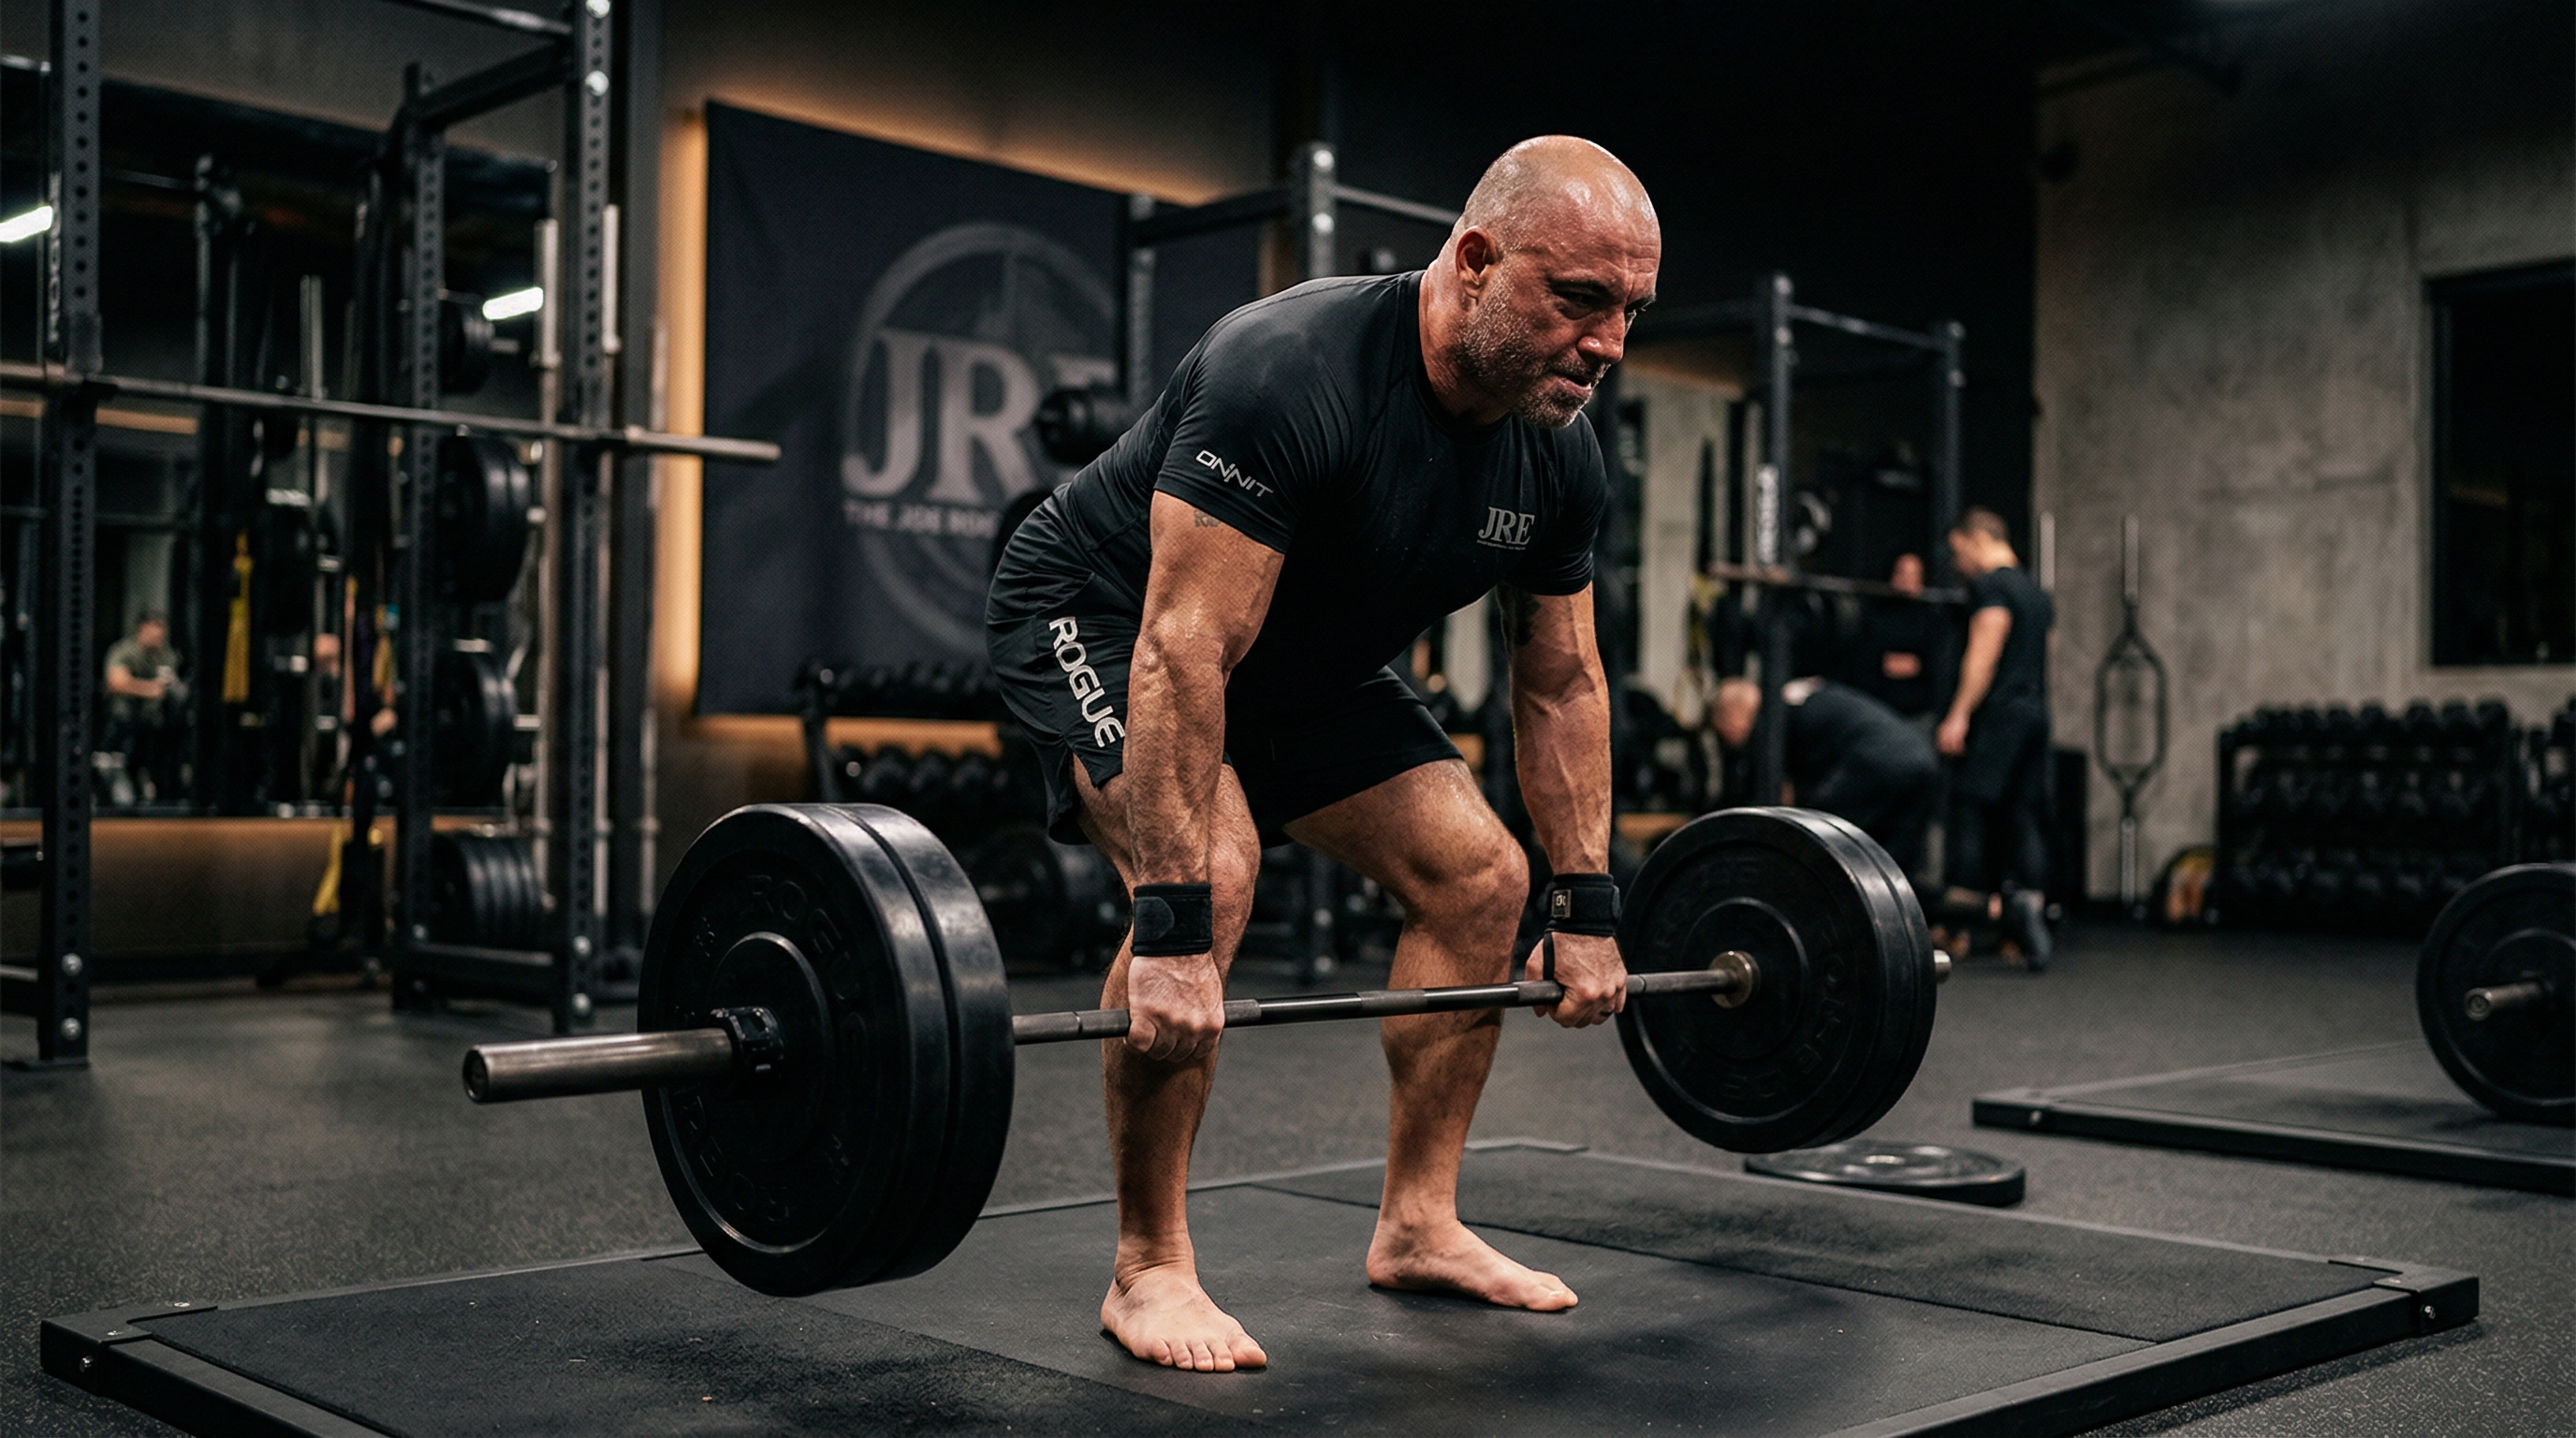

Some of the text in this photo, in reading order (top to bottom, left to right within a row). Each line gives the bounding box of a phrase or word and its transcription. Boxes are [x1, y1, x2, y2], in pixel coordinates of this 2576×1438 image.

[1195, 450, 1273, 497] ONNIT
[1478, 506, 1535, 545] JRE
[1048, 616, 1125, 747] ROGUE
